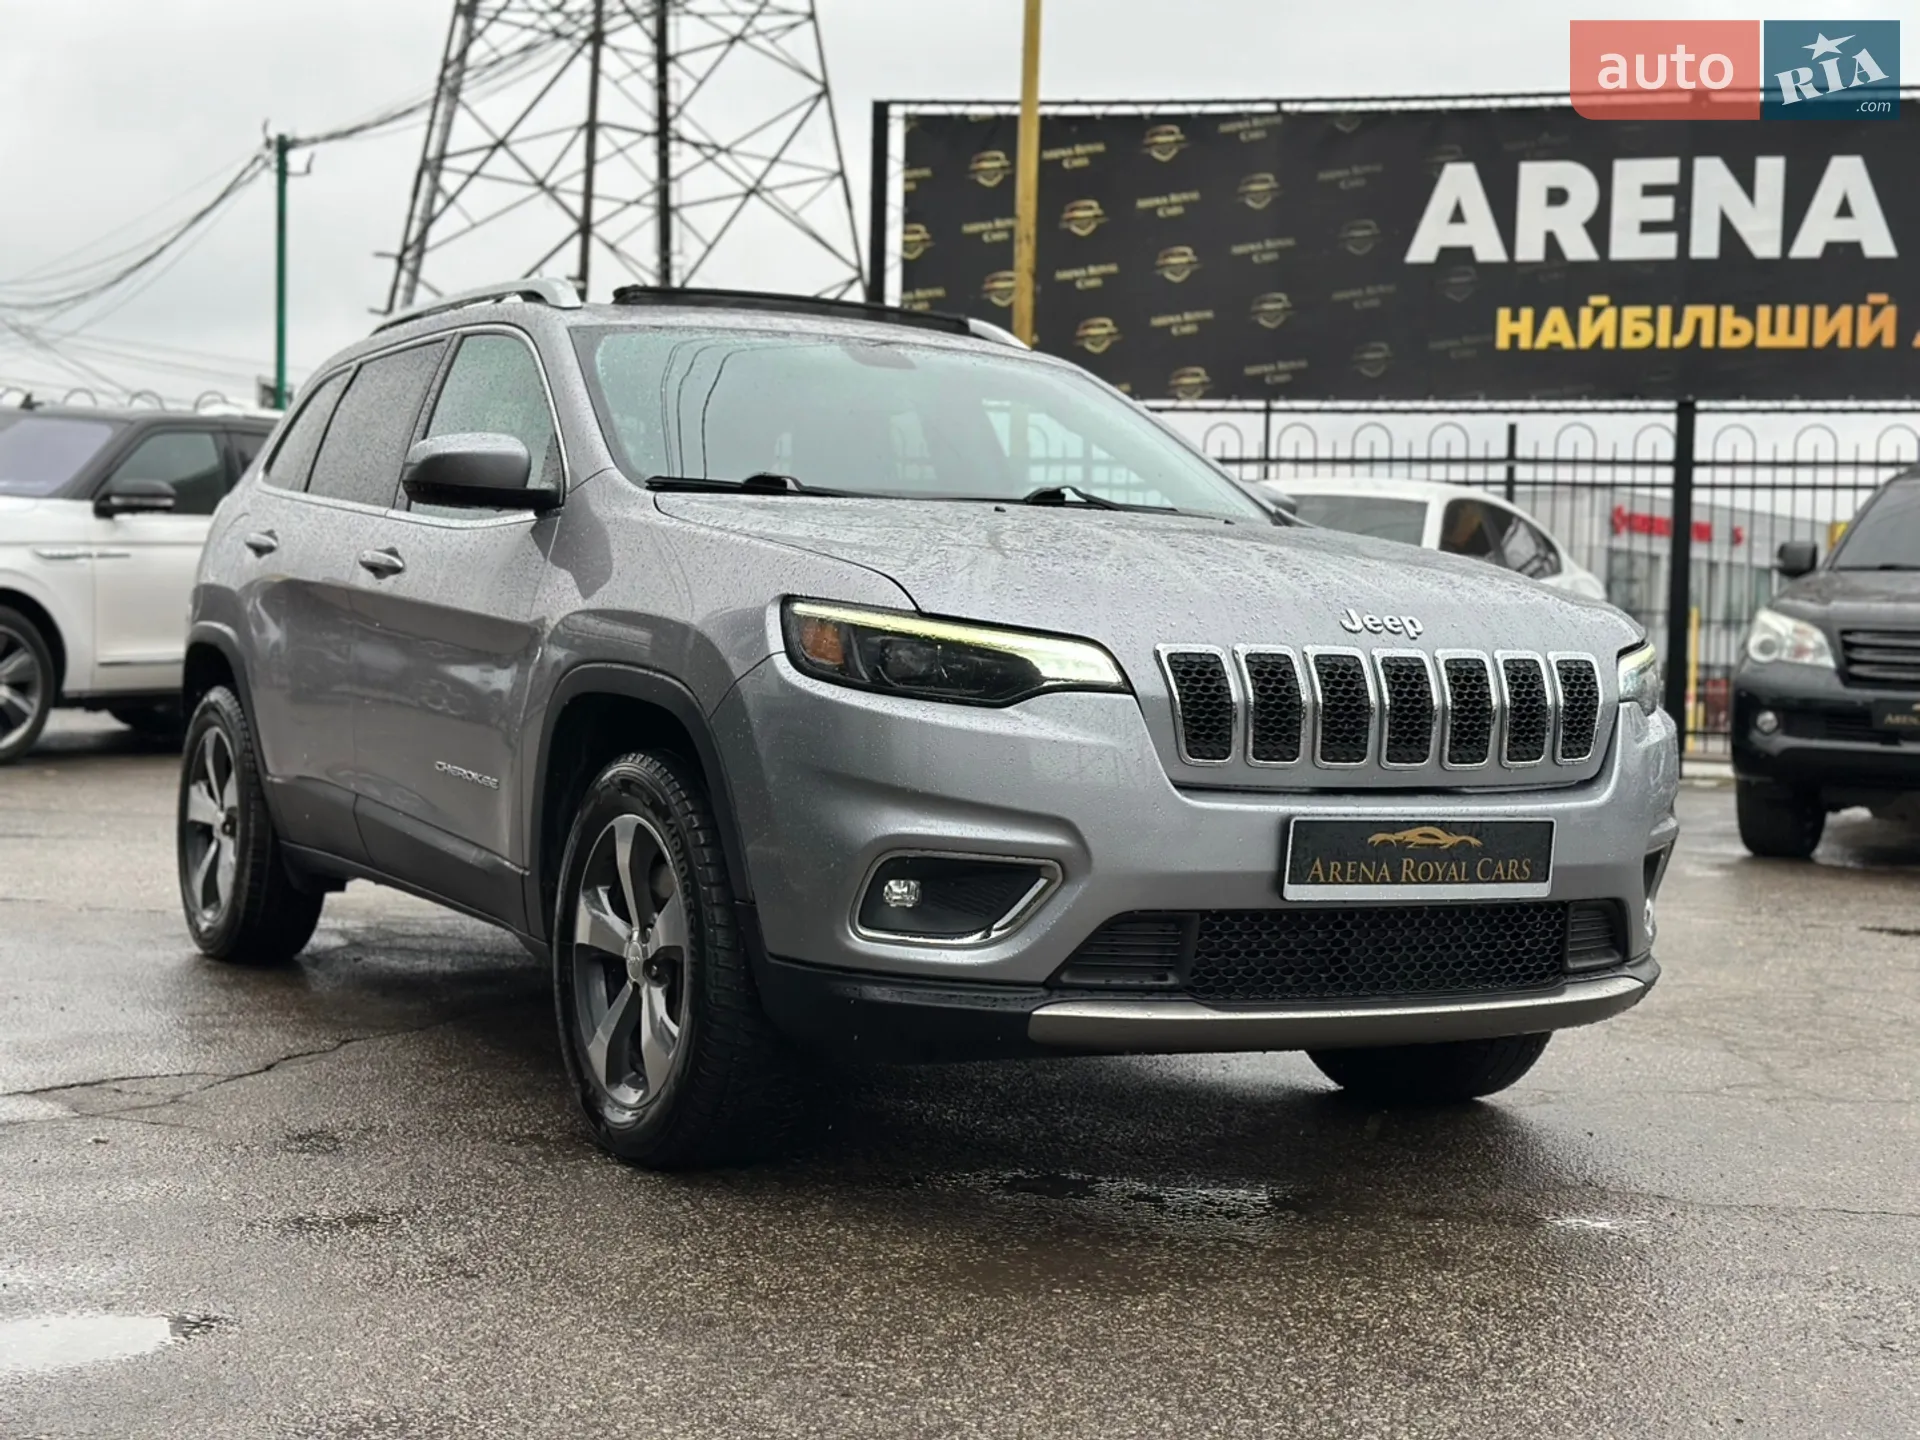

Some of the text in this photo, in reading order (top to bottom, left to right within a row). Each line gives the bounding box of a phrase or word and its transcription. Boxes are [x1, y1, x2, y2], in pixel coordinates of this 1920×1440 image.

[1403, 154, 1900, 264] ARENA
[1495, 293, 1898, 350] НАЙБІЛЬШИЙ
[1339, 608, 1424, 640] Jeep
[434, 760, 500, 790] CHEROKEE
[1306, 856, 1532, 883] ARENA ROYAL CARS
